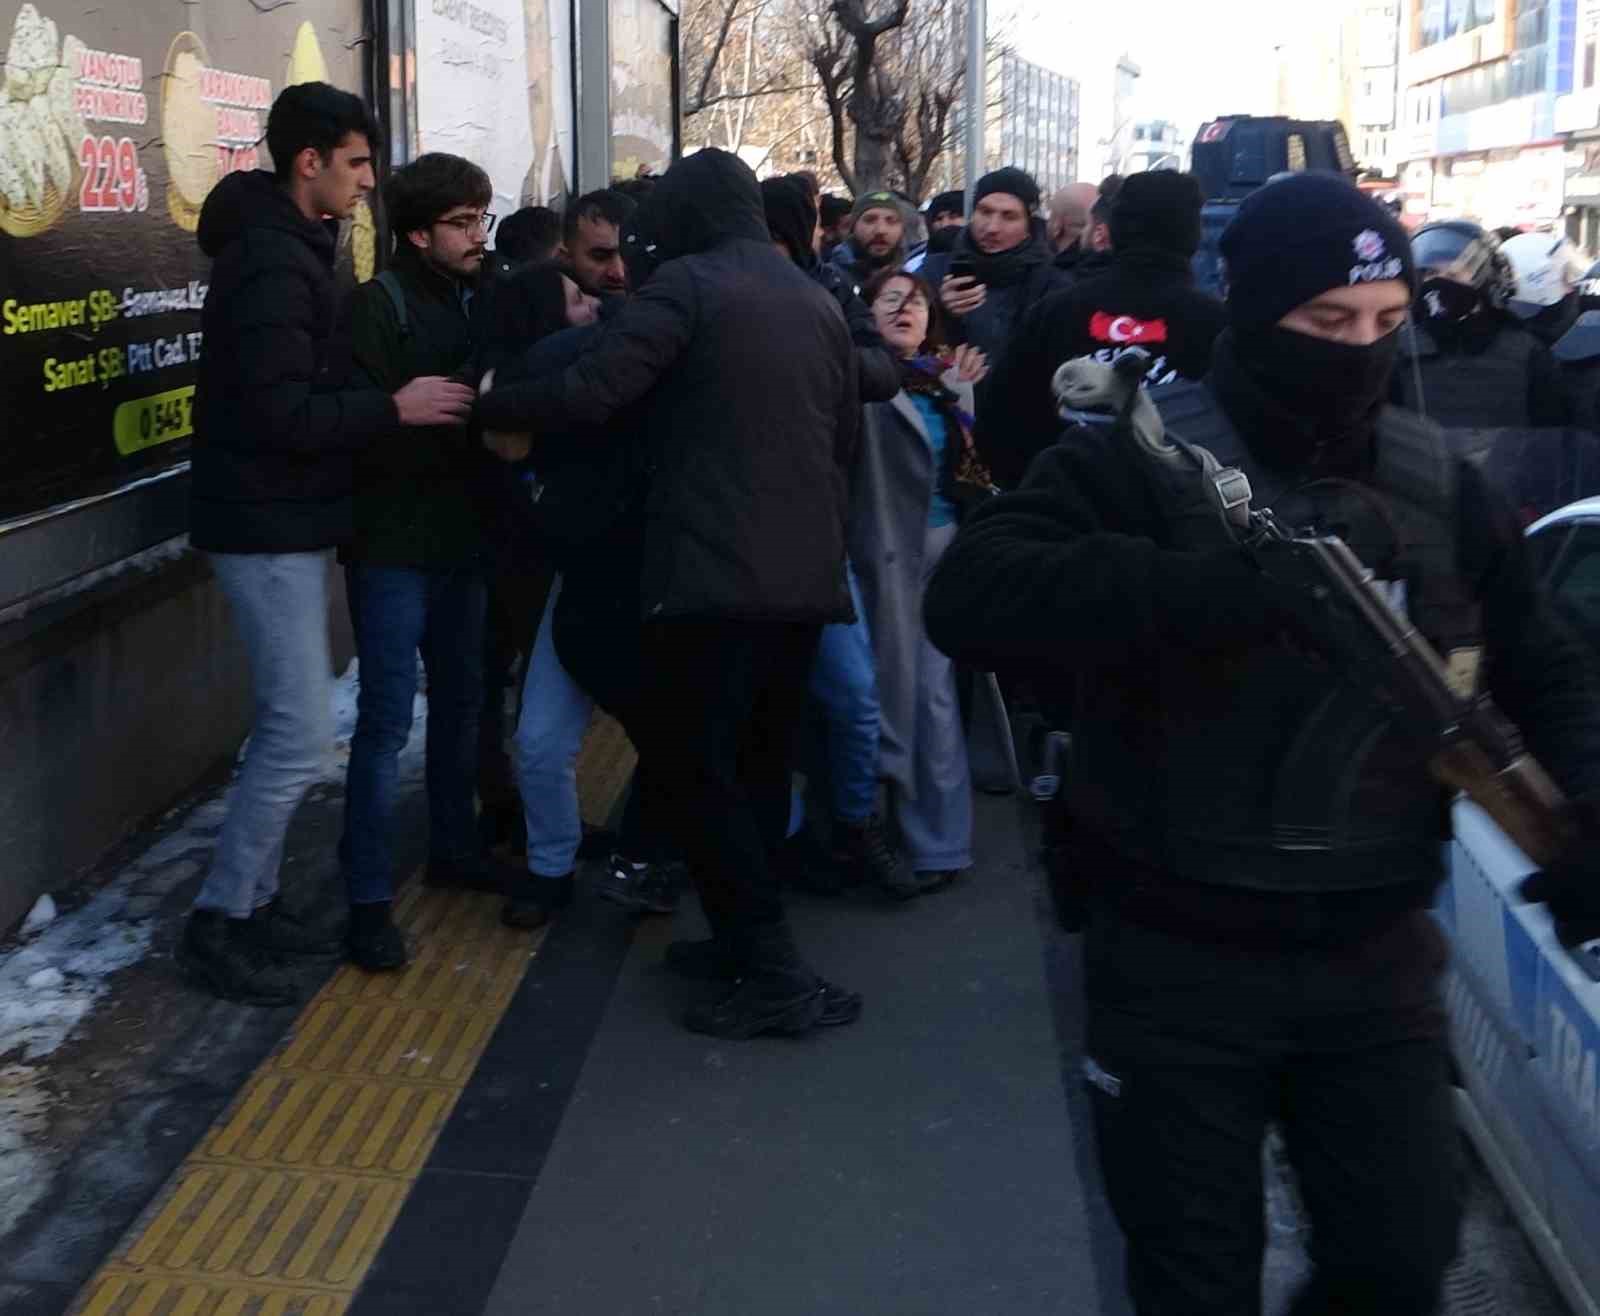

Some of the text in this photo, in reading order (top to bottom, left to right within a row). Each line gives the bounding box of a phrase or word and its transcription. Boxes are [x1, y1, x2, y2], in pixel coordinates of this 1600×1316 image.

[81, 134, 137, 212] 229
[3, 299, 86, 334] Semaver
[44, 356, 96, 391] Sanat
